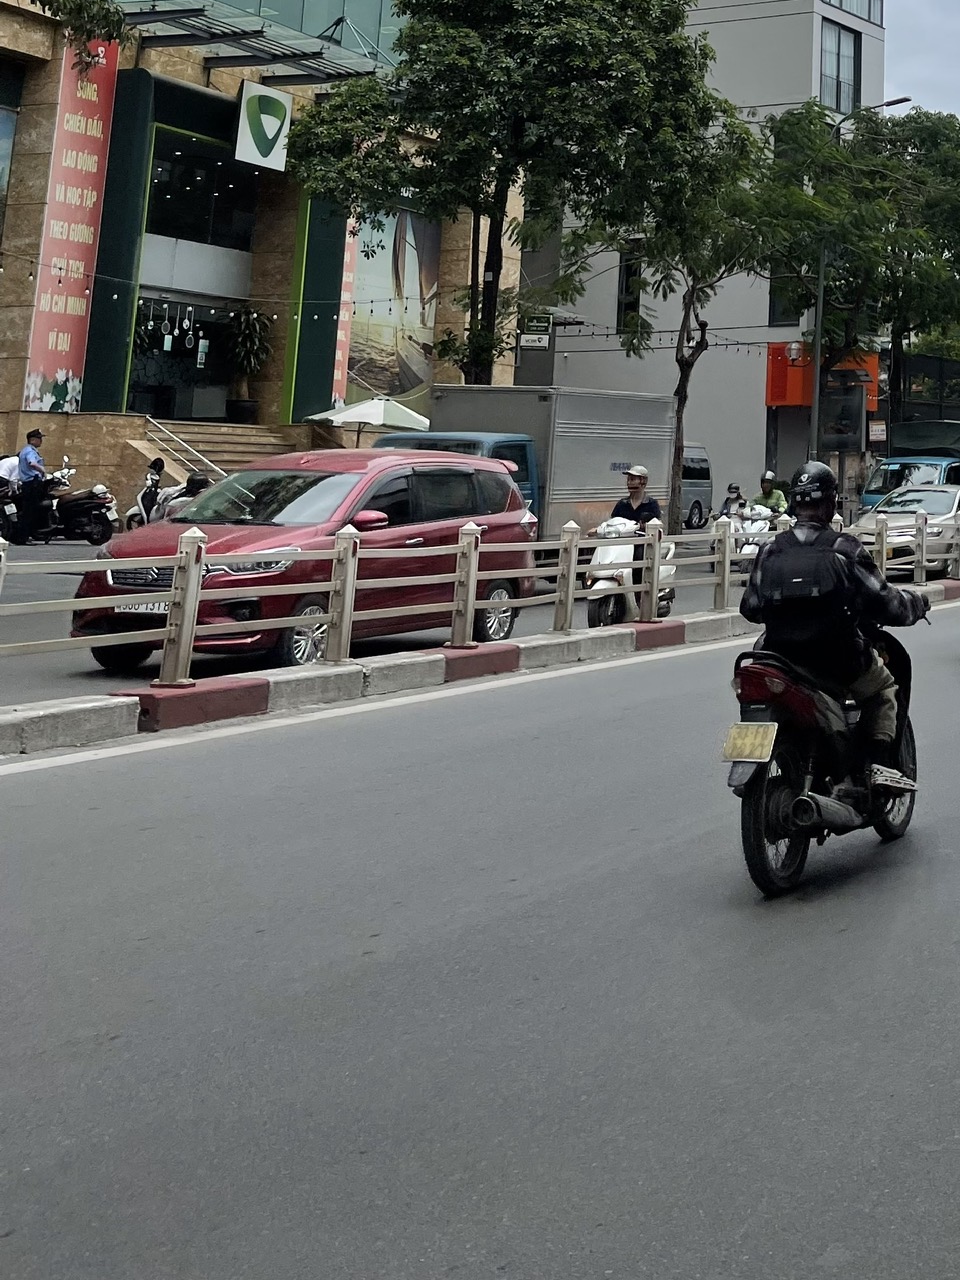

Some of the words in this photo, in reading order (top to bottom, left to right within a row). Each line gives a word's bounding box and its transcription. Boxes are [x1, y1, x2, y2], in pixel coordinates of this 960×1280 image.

[62, 148, 76, 169] LAO
[77, 149, 98, 174] ĐỘNG
[55, 181, 66, 204] VÀ
[66, 186, 81, 208] HỌC
[49, 220, 68, 240] THEO
[68, 258, 85, 282] TỊCH
[39, 287, 51, 312] HỒ
[51, 291, 66, 314] CHÍ
[66, 295, 87, 316] MINH
[48, 328, 58, 351] VĨ
[58, 332, 71, 355] ĐẠI
